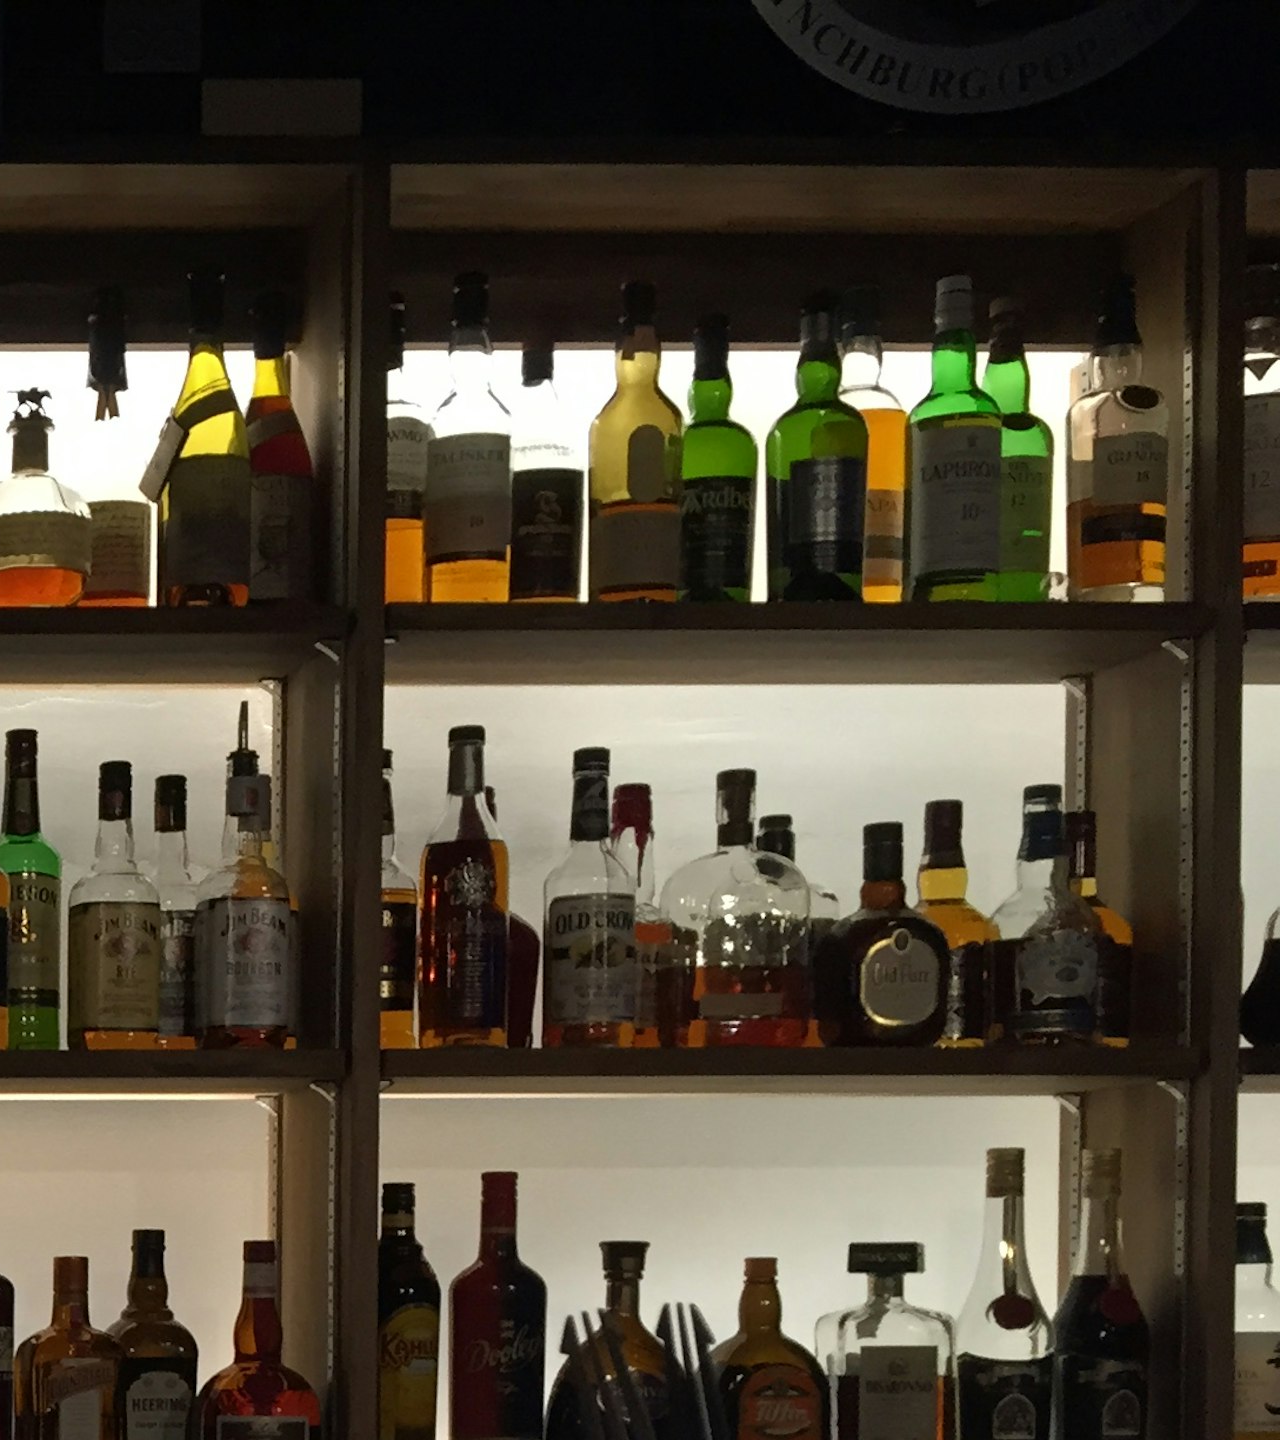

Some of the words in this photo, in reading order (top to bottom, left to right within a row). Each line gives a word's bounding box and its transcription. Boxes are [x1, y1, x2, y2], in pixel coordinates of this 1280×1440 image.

[432, 447, 506, 468] TALISKER
[555, 913, 589, 936] OLD
[131, 1397, 187, 1413] HEERING
